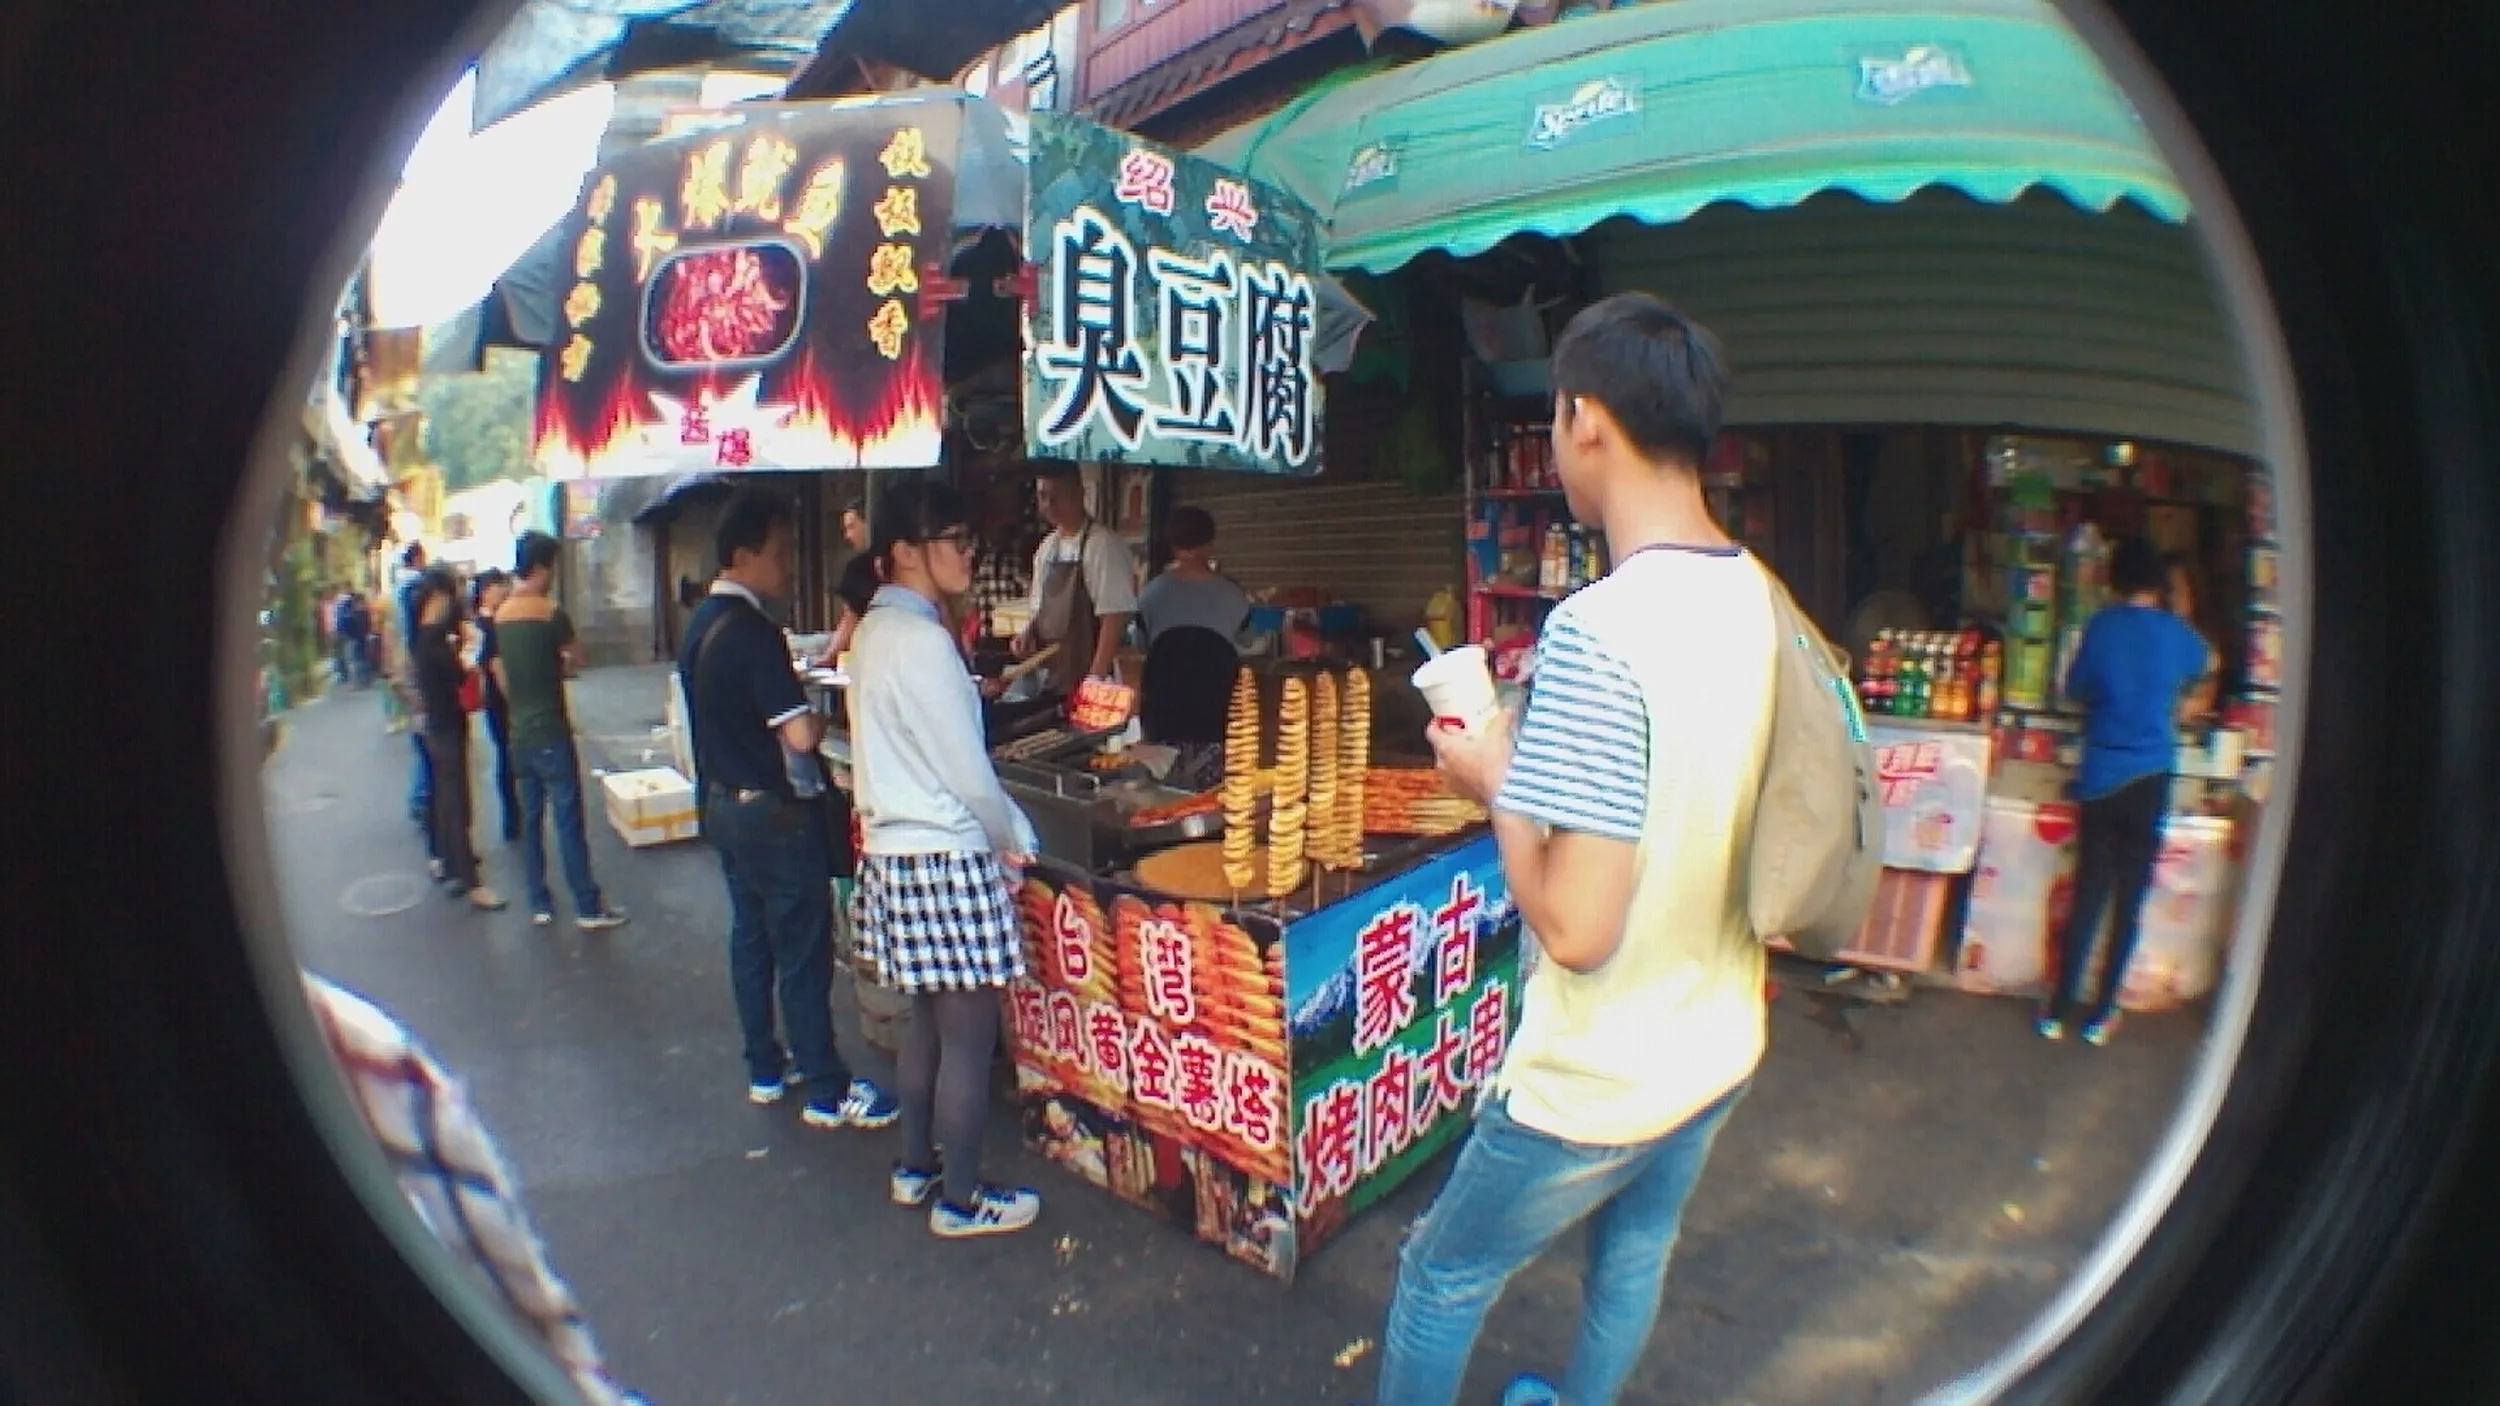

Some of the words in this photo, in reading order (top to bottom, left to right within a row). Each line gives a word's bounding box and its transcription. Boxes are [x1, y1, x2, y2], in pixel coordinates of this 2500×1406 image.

[1117, 150, 1257, 243] 绍兴
[1041, 208, 1315, 463] 臭豆腐
[1055, 893, 1193, 1022] 台湾
[1355, 873, 1483, 1055] 蒙古
[1301, 984, 1508, 1216] 烤肉大串
